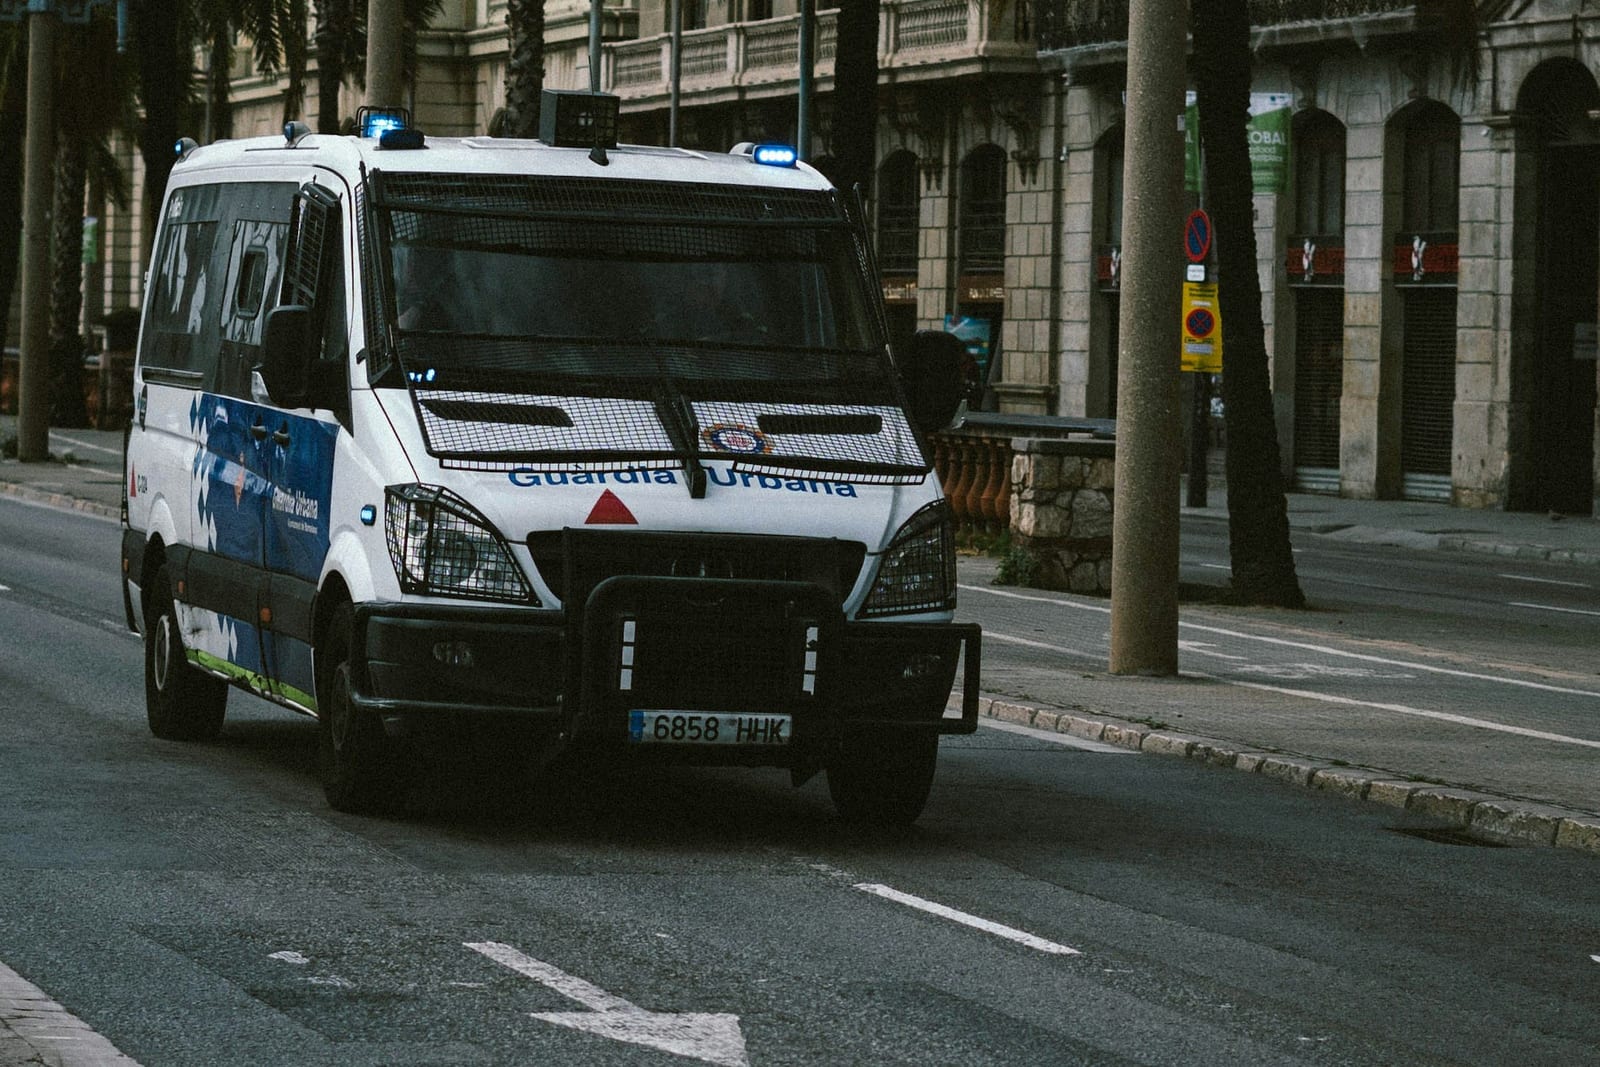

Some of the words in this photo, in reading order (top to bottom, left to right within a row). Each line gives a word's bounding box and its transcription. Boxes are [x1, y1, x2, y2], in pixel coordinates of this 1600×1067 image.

[707, 467, 859, 498] Urbana
[654, 714, 720, 741] 6858
[736, 717, 786, 743] HHK
